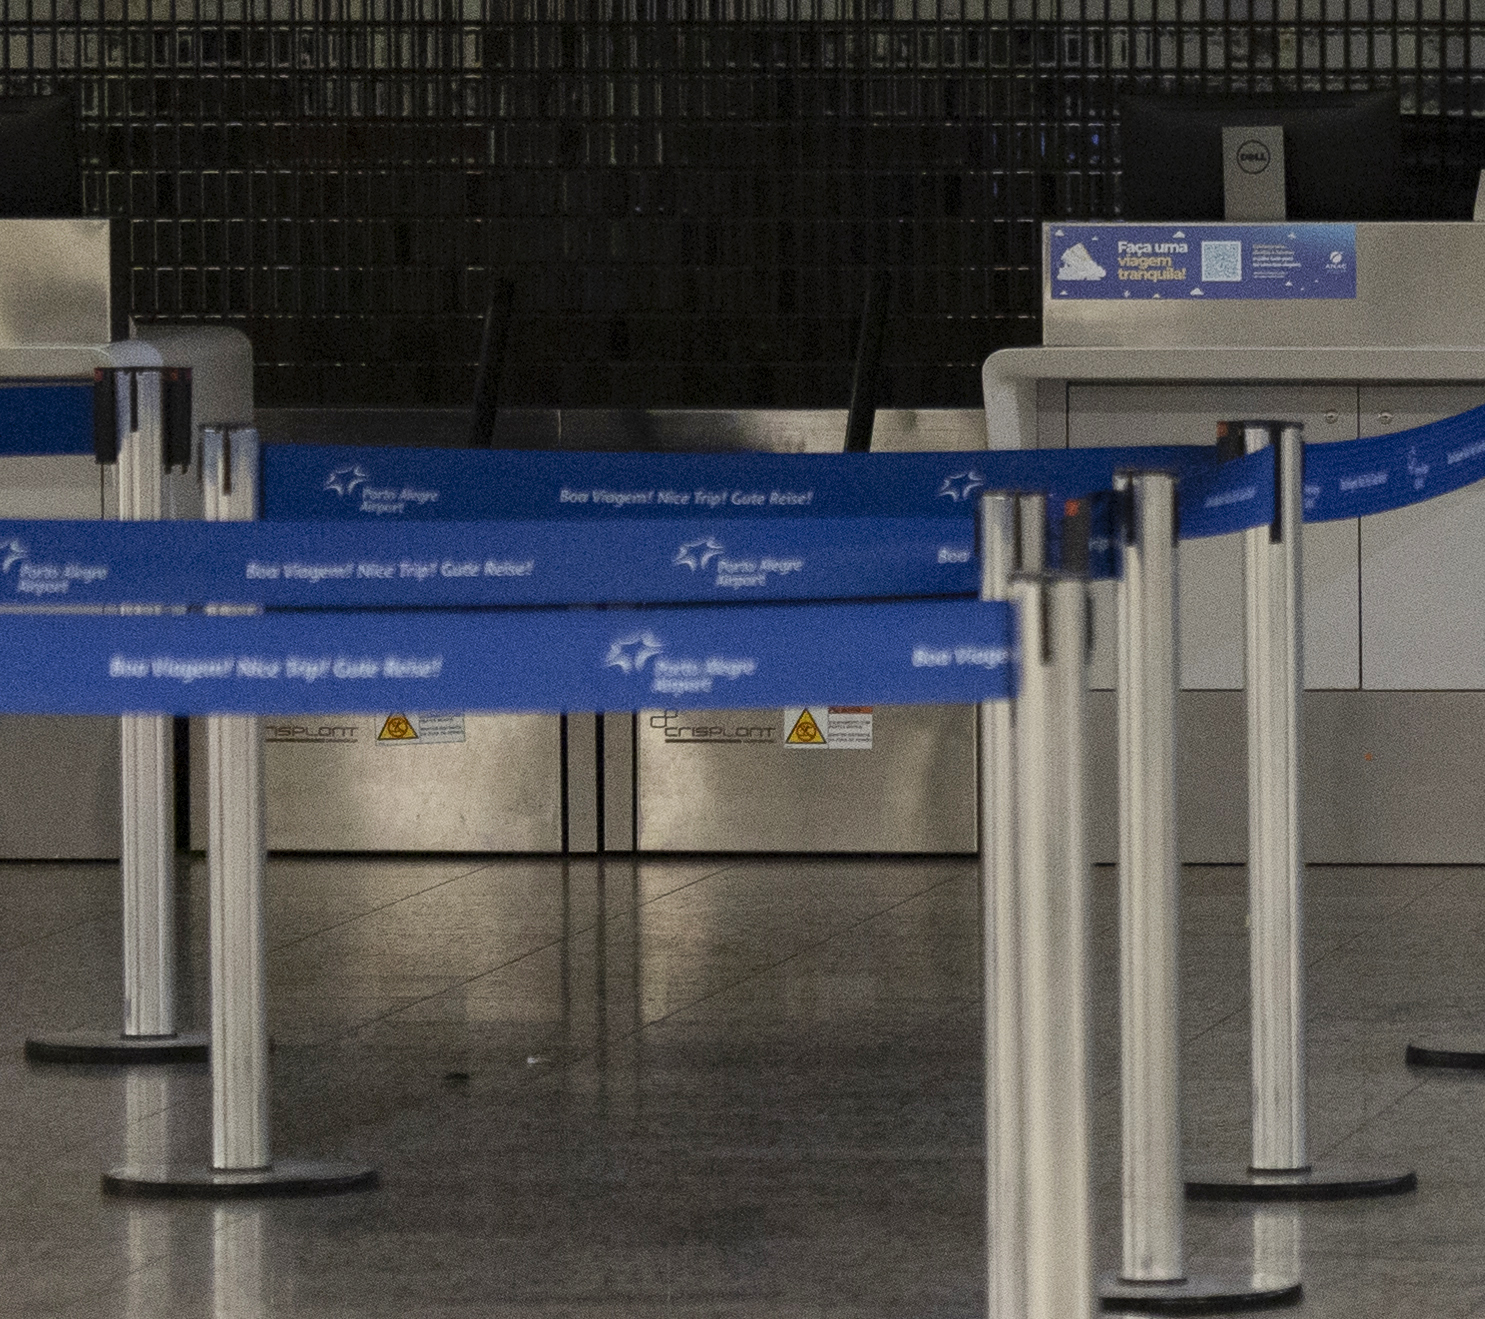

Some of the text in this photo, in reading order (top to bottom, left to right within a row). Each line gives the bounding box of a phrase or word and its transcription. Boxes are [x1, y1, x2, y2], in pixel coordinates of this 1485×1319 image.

[1118, 241, 1188, 256] Faça uma
[1118, 255, 1172, 269] viagem
[1118, 267, 1187, 282] tranquila!
